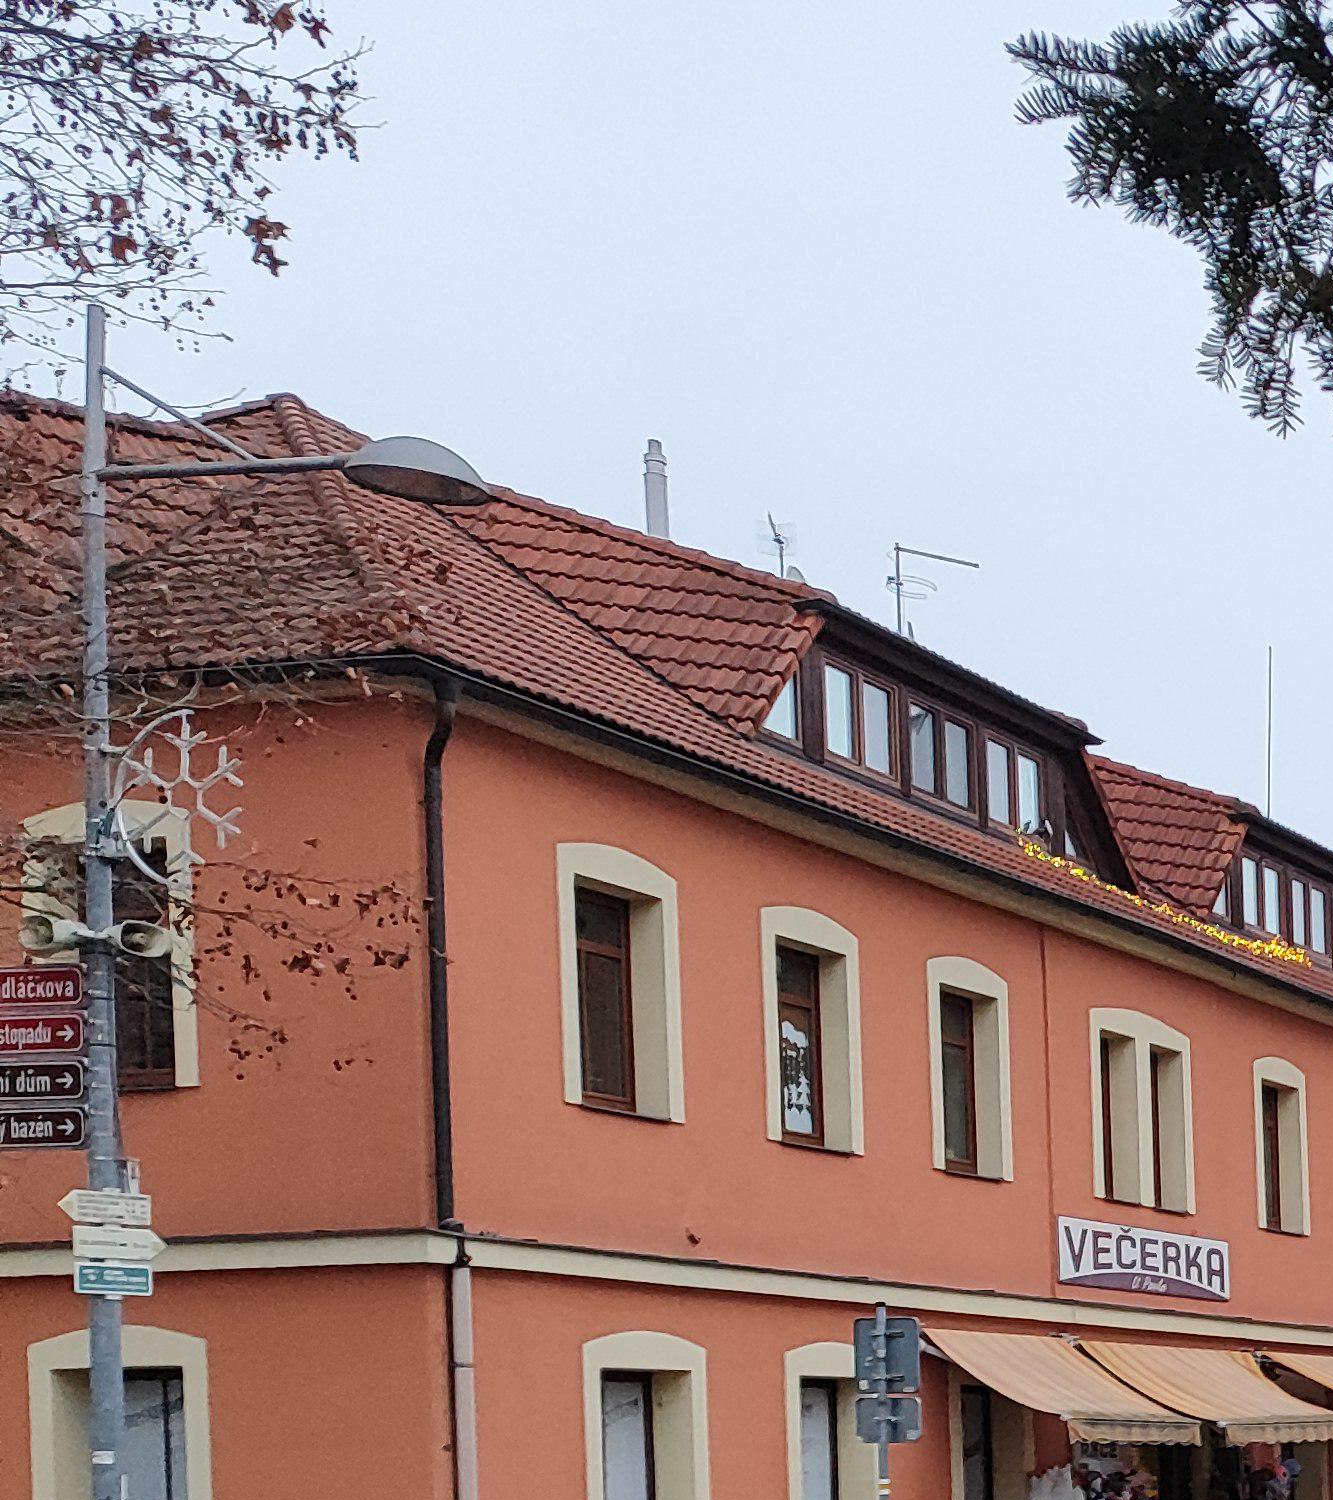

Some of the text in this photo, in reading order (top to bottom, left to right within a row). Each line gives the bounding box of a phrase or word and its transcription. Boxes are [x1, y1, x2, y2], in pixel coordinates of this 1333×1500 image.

[16, 1069, 50, 1093] dům
[10, 1114, 53, 1139] bazén
[1063, 1225, 1226, 1293] VEČERKA
